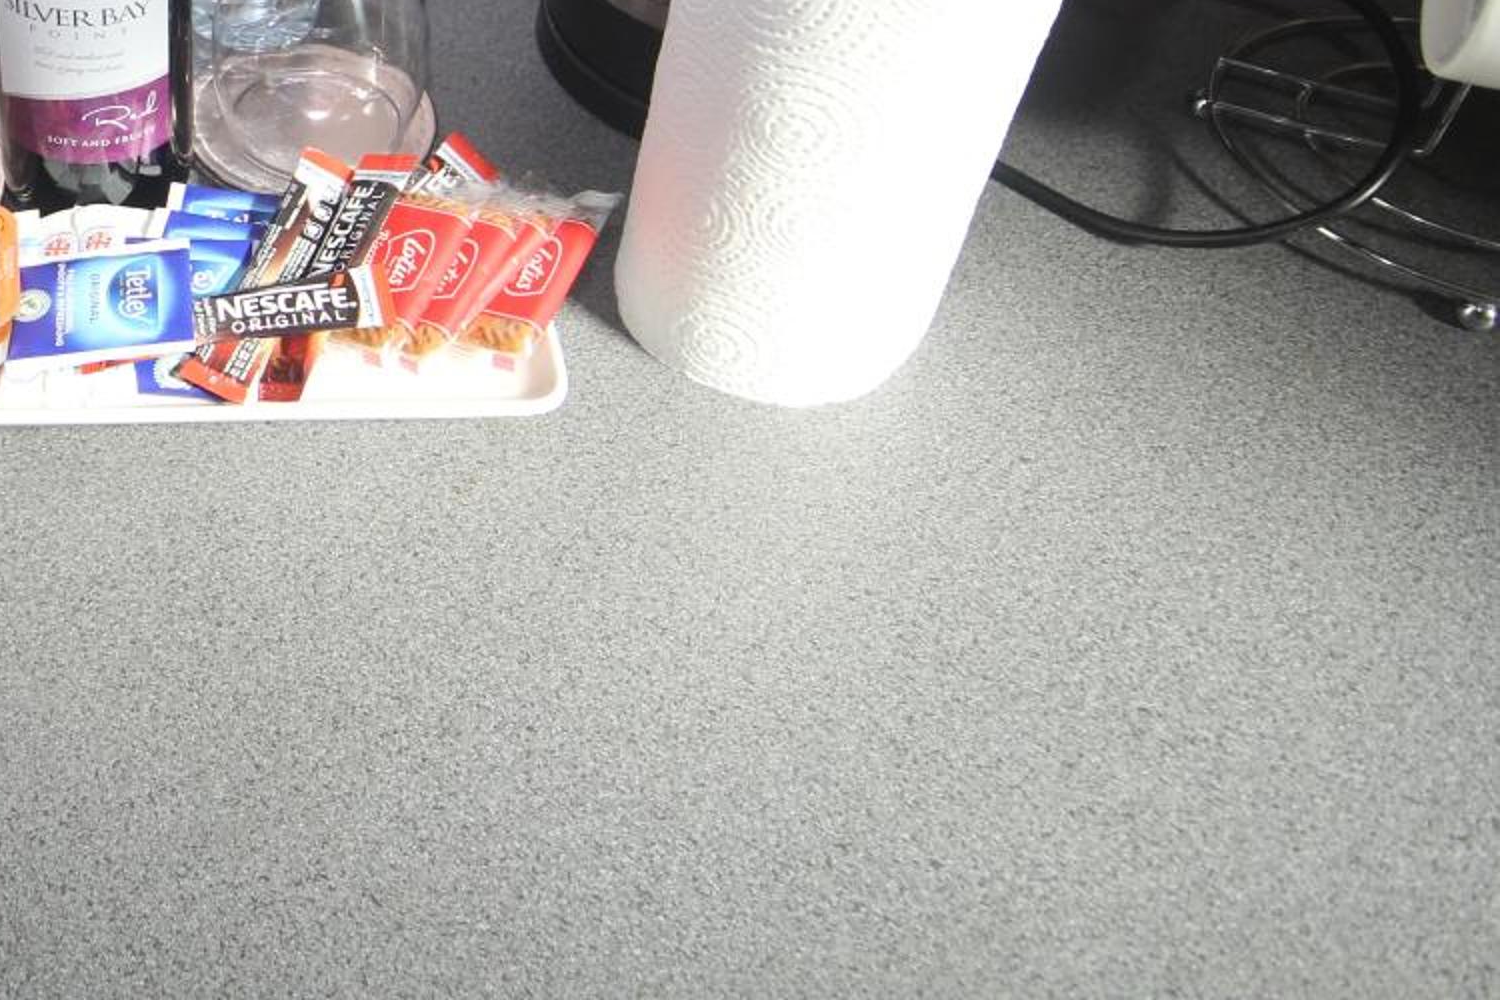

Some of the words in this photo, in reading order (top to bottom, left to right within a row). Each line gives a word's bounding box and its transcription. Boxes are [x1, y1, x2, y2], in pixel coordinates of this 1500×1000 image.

[101, 0, 149, 26] BAY
[81, 89, 159, 131] Red
[82, 138, 112, 148] AND
[389, 238, 427, 286] Lotus
[118, 264, 153, 321] Tetley
[231, 311, 348, 334] ORIGINAL
